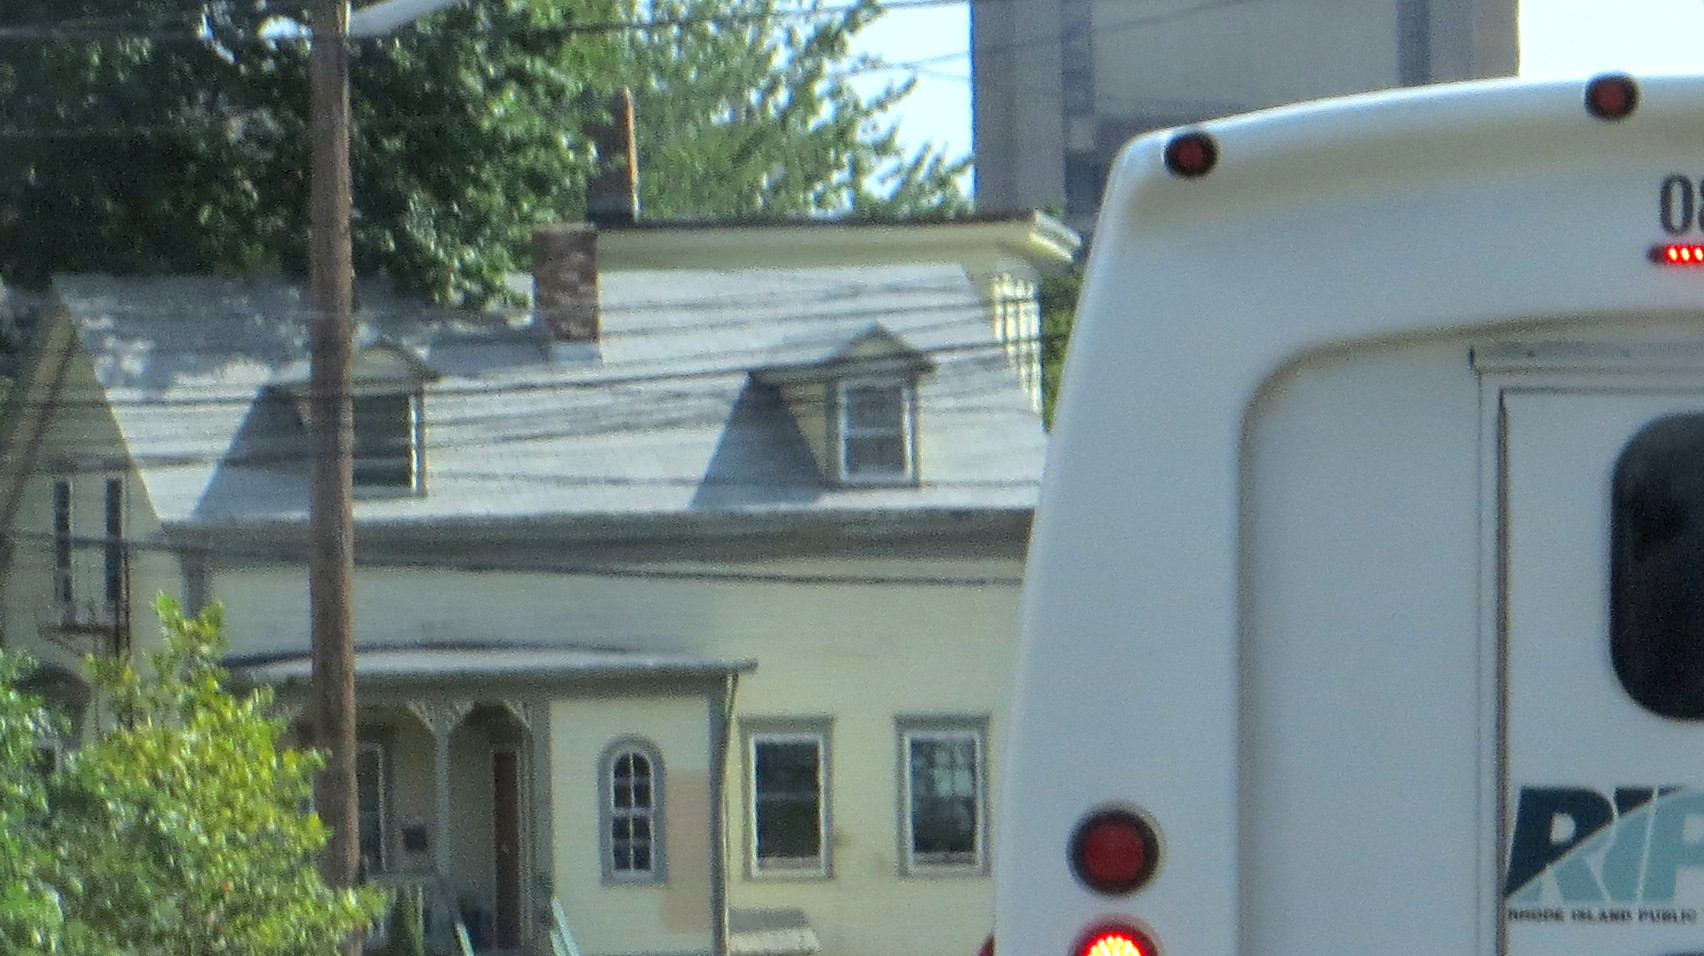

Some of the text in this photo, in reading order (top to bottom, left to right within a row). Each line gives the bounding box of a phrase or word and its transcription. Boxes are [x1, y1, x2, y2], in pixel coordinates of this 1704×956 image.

[1508, 910, 1564, 923] RHODE
[1572, 910, 1633, 923] ISLAND
[1638, 910, 1697, 924] PUBLIC
